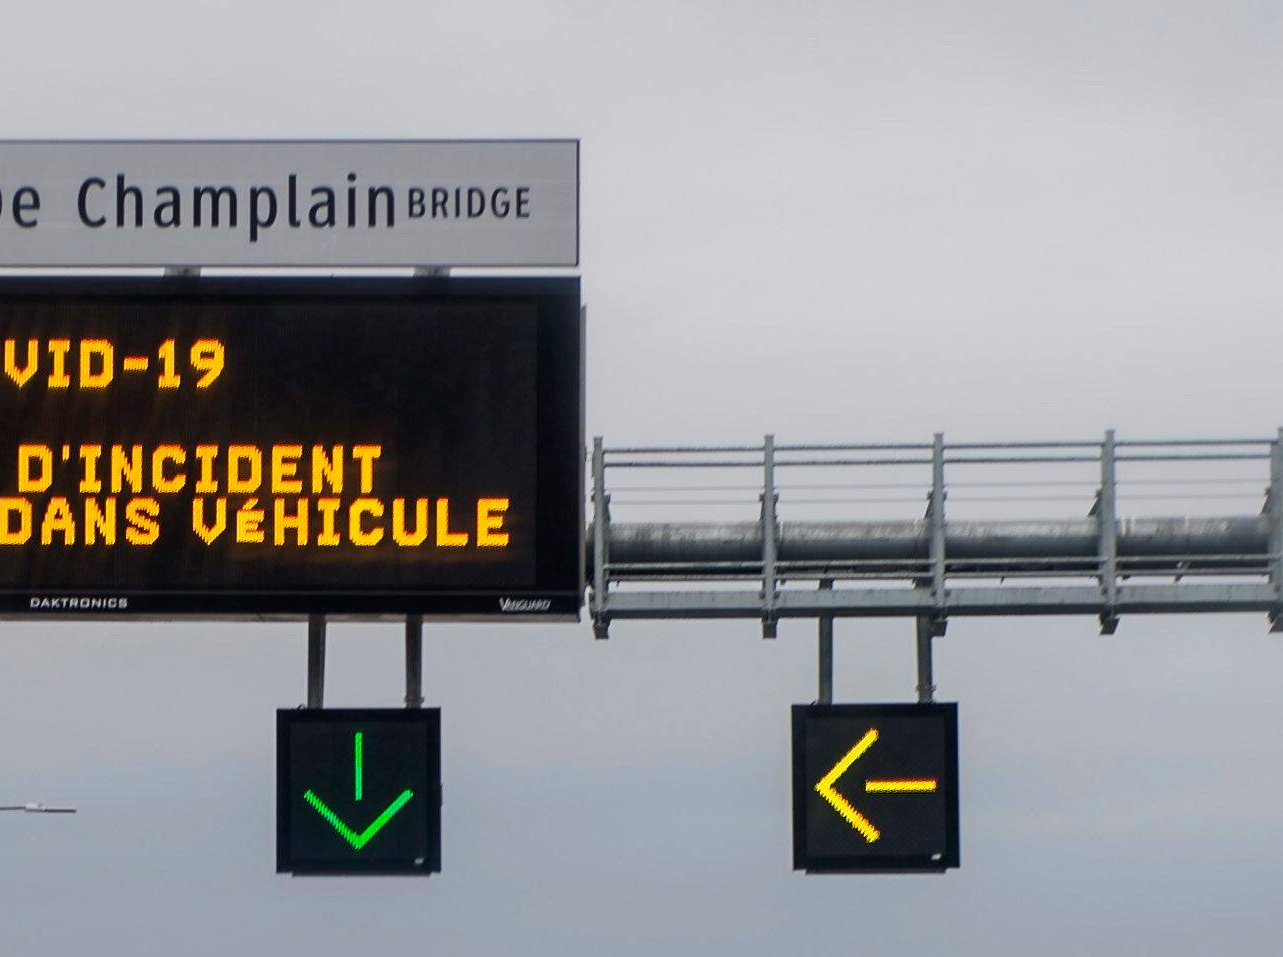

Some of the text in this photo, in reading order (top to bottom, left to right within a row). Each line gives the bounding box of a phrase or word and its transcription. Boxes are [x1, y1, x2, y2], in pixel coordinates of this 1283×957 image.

[77, 172, 396, 243] Champlain
[408, 186, 531, 219] BRIDGE
[17, 443, 382, 495] D'INCIDENT
[29, 597, 128, 609] DAKTRONICS
